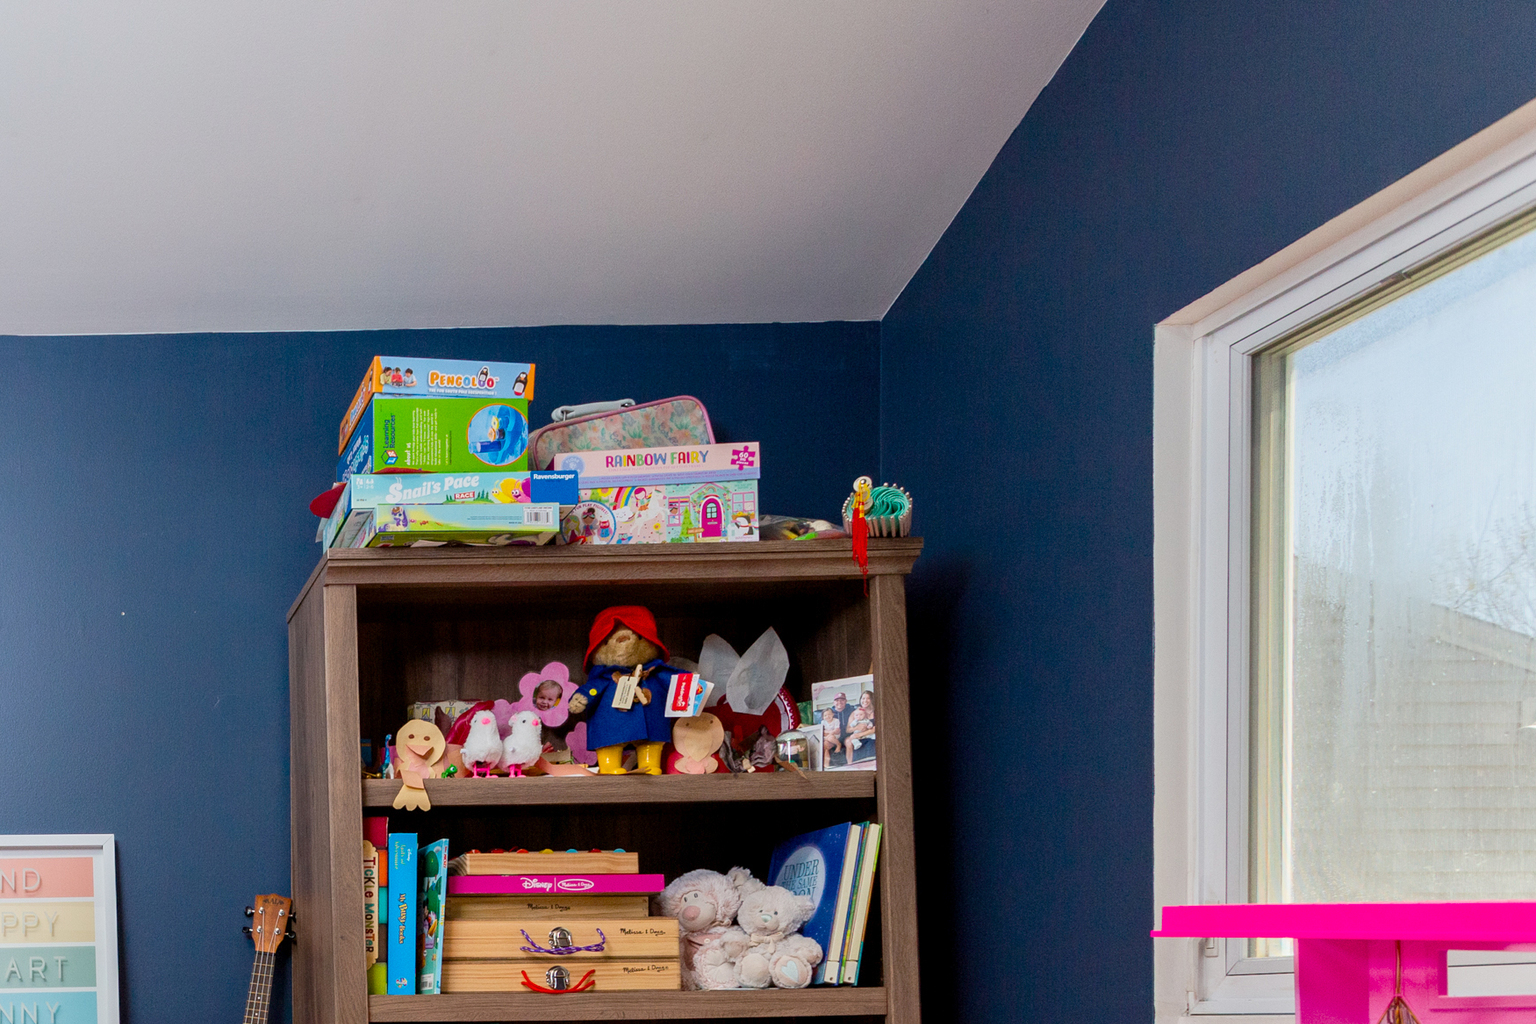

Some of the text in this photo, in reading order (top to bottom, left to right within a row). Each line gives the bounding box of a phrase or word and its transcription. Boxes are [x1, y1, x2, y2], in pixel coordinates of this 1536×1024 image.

[606, 450, 708, 468] RAINBOW FAIRY
[533, 473, 575, 481] Ravensburger
[386, 475, 480, 503] Snail's Pace
[783, 859, 819, 881] UNDER
[520, 877, 553, 891] Disney
[796, 876, 817, 890] SAME
[398, 903, 407, 924] Busy
[398, 925, 406, 944] Books
